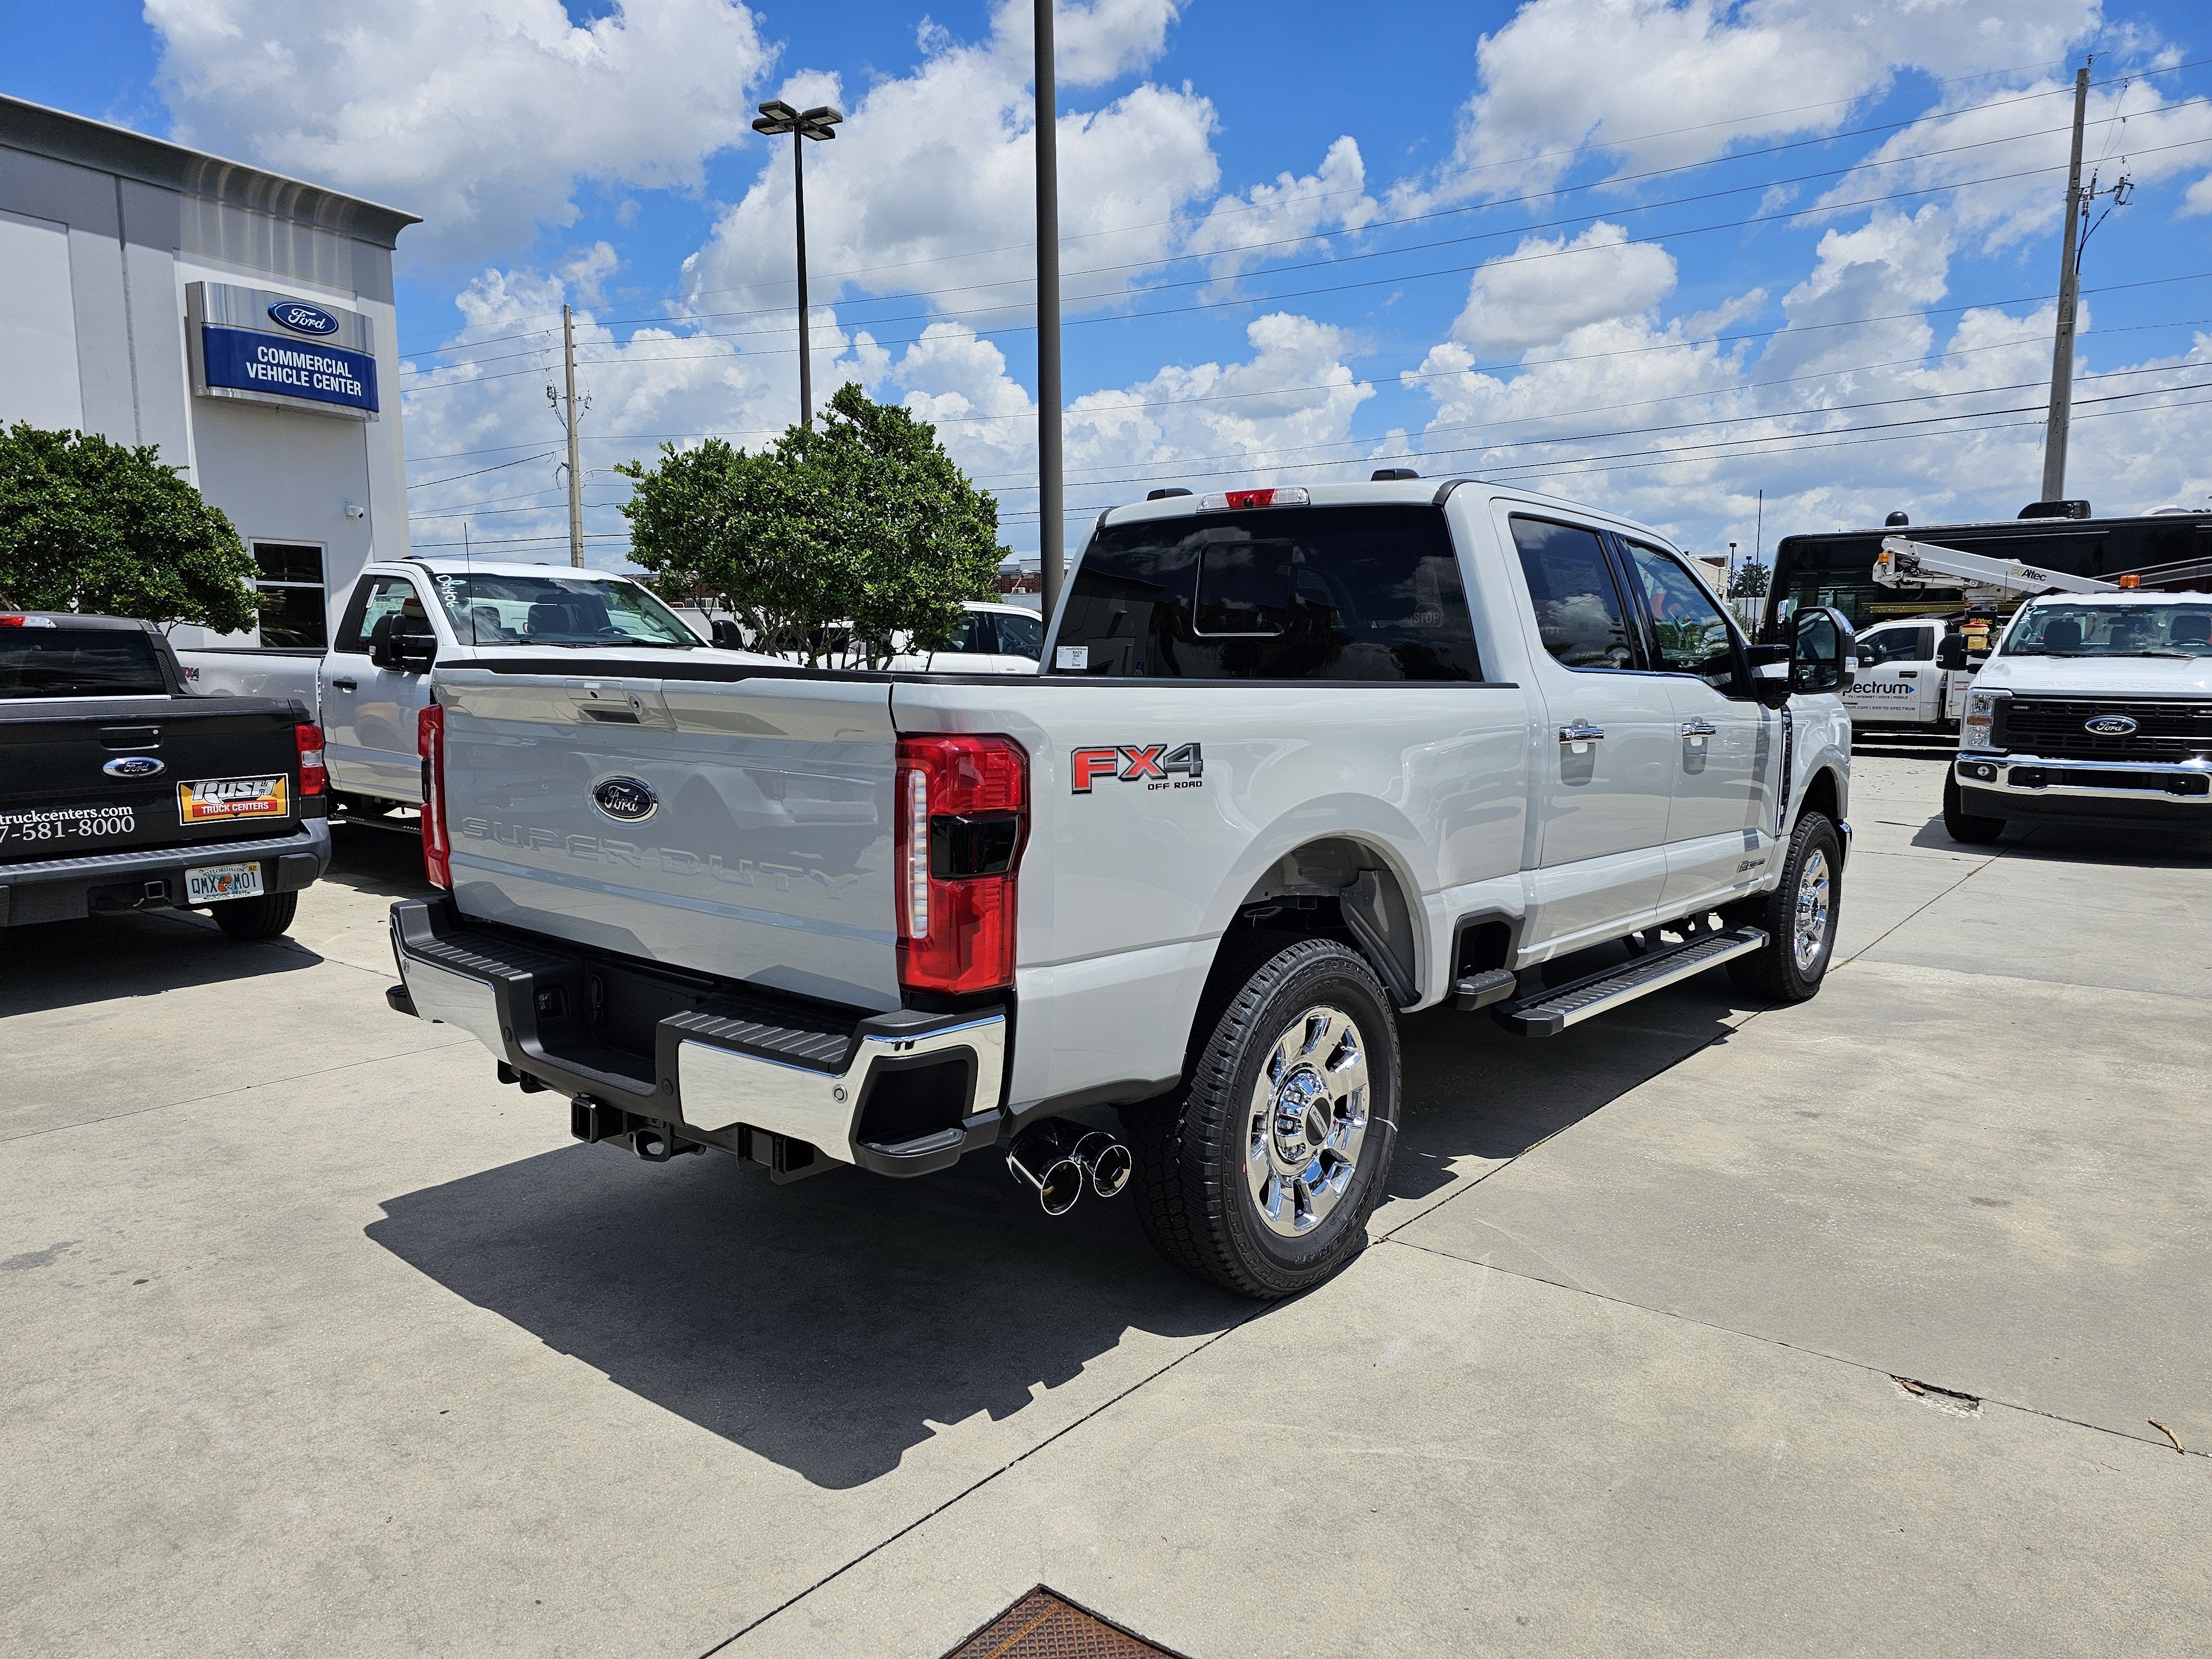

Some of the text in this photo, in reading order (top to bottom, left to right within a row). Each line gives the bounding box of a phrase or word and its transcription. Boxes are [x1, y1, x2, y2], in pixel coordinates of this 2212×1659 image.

[288, 308, 326, 329] Ford
[257, 346, 352, 378] COMMERCIAL
[246, 362, 362, 397] VEHICLE CENTER
[2021, 568, 2047, 581] Altec
[1413, 612, 1439, 623] STOP
[1842, 681, 1908, 697] pectrum
[2096, 721, 2124, 732] Ford
[123, 761, 149, 773] Ford
[1071, 742, 1203, 796] FX4
[1174, 780, 1203, 789] ROAD
[604, 785, 639, 812] Ford
[201, 802, 269, 815] TRUCK CENTERS
[461, 816, 859, 901] SUPER DUTY
[191, 876, 218, 895] QMX
[206, 891, 231, 900] SUNSHINE
[1313, 1110, 1326, 1133] FORD
